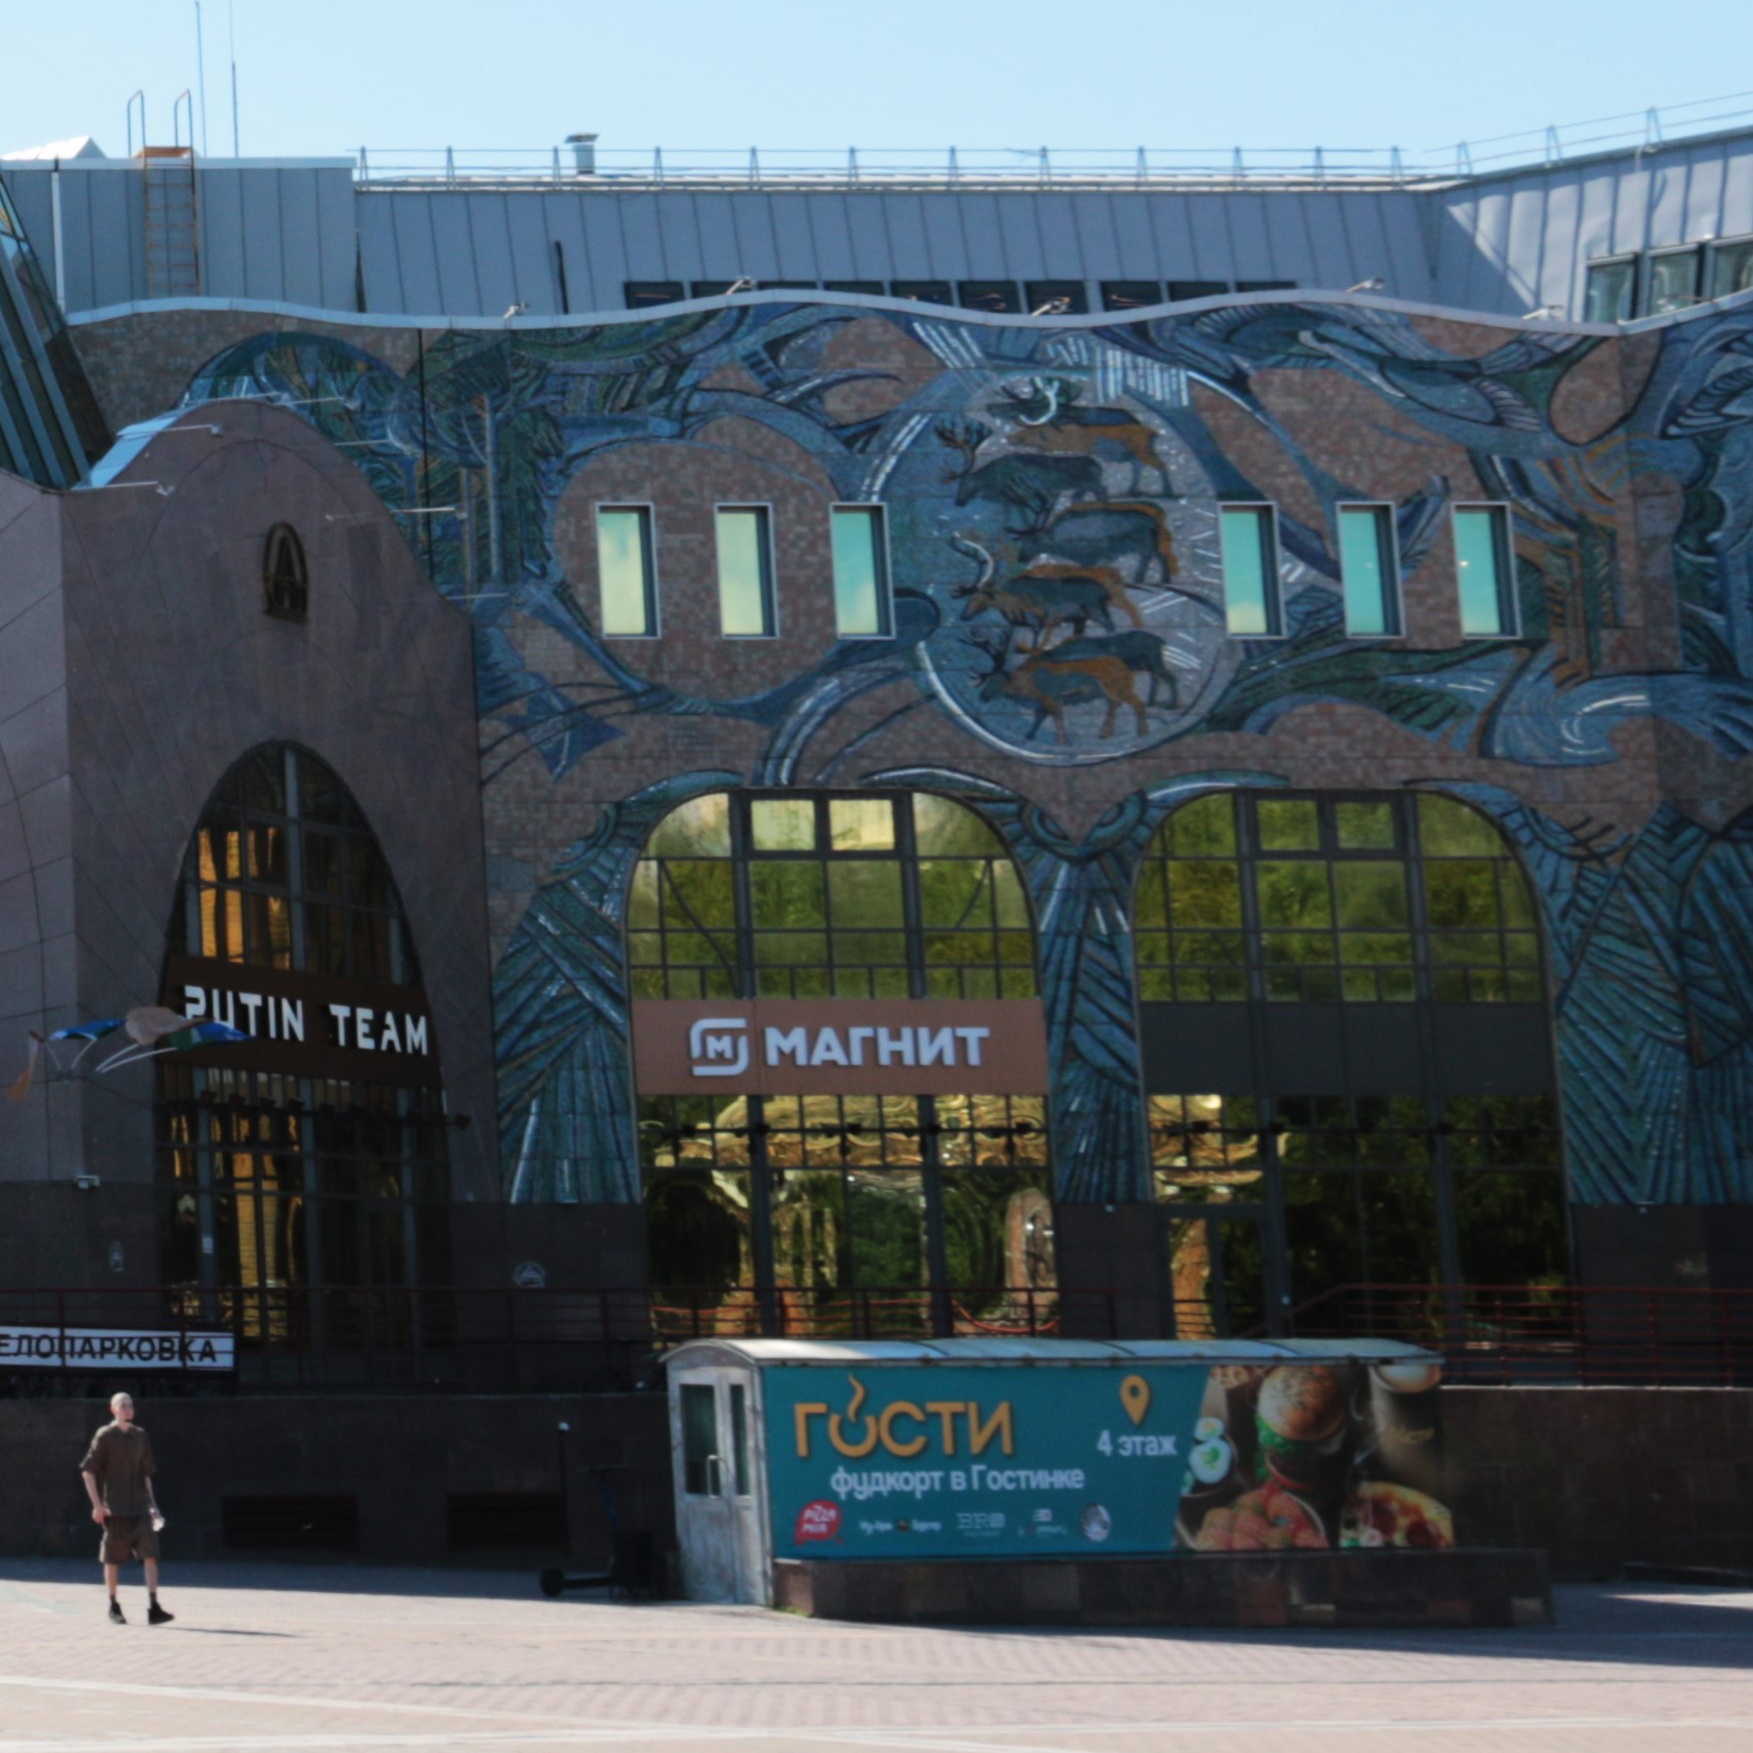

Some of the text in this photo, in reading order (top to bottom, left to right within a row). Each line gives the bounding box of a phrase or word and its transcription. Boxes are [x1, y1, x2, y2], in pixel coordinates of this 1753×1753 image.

[184, 985, 428, 1056] PUTIN TEAM
[764, 1027, 989, 1067] МАГНИТ
[794, 1374, 1014, 1458] ГОСТИ
[1096, 1430, 1178, 1456] 4 этаж
[830, 1464, 1086, 1499] фудкорт в Гостинке
